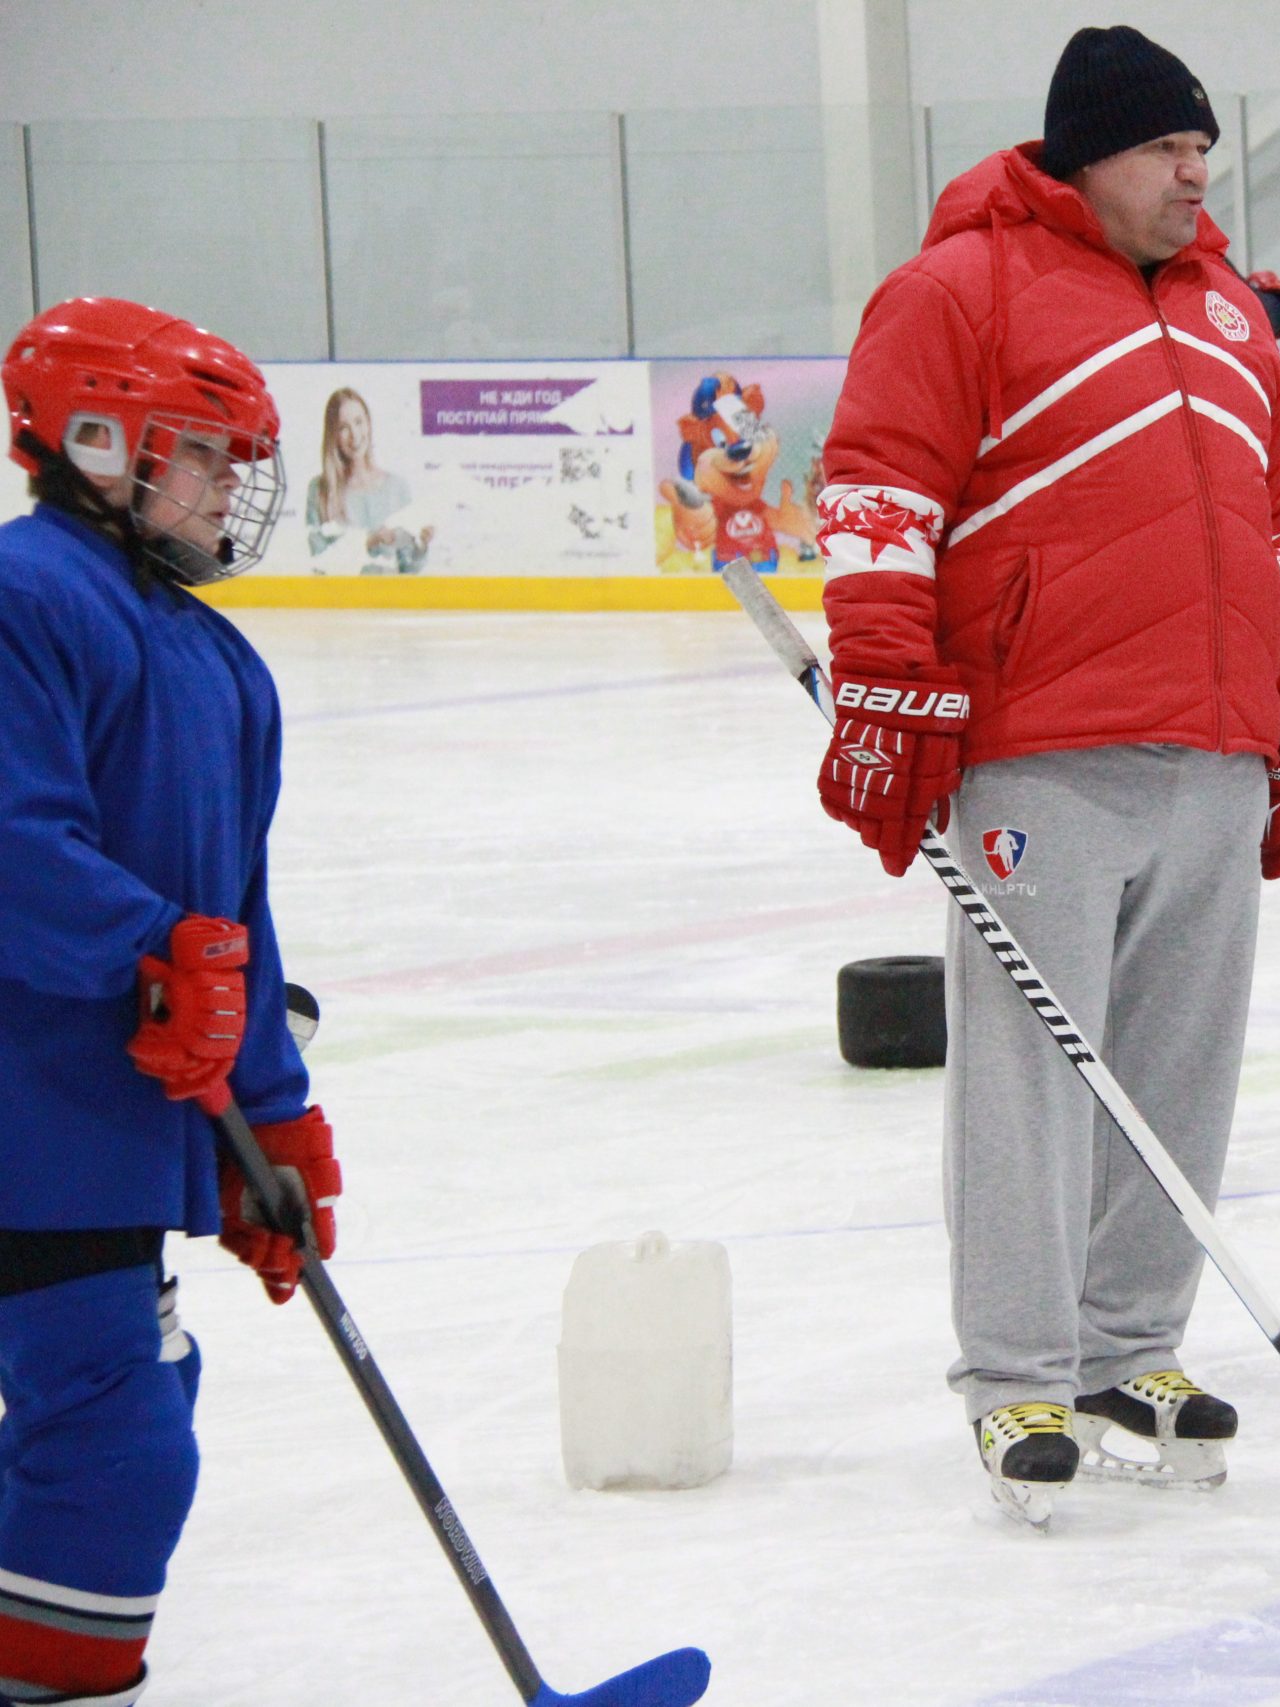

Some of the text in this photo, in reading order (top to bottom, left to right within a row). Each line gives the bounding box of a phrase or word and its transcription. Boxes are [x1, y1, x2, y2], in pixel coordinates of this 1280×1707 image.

[480, 389, 562, 407] НЕ ЖДИ ГОД
[436, 408, 547, 425] ПОСТУПАЙ ПРЯМ
[434, 1495, 489, 1585] NORDWAY
